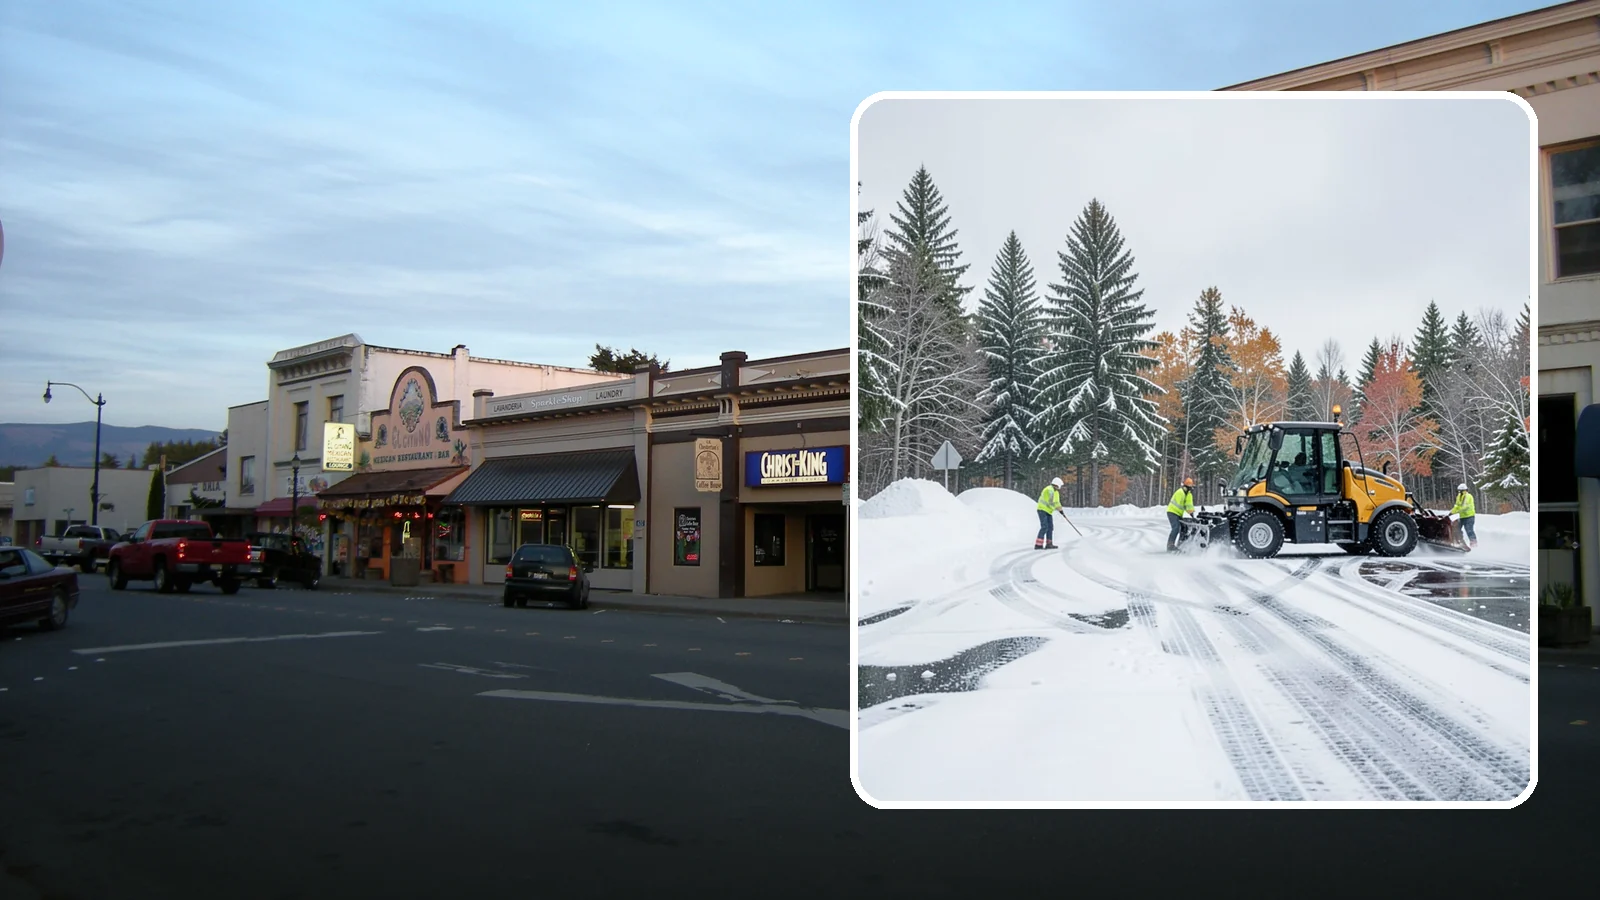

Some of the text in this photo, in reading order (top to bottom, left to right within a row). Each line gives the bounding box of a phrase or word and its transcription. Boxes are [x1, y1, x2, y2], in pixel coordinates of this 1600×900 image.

[563, 394, 582, 404] Shop
[595, 389, 623, 400] LAUNDRY
[493, 402, 522, 412] LAVANDERIA
[373, 455, 396, 464] MEXICAN
[398, 451, 433, 462] RESTAURANT
[438, 450, 450, 459] BAR
[799, 450, 827, 476] KING
